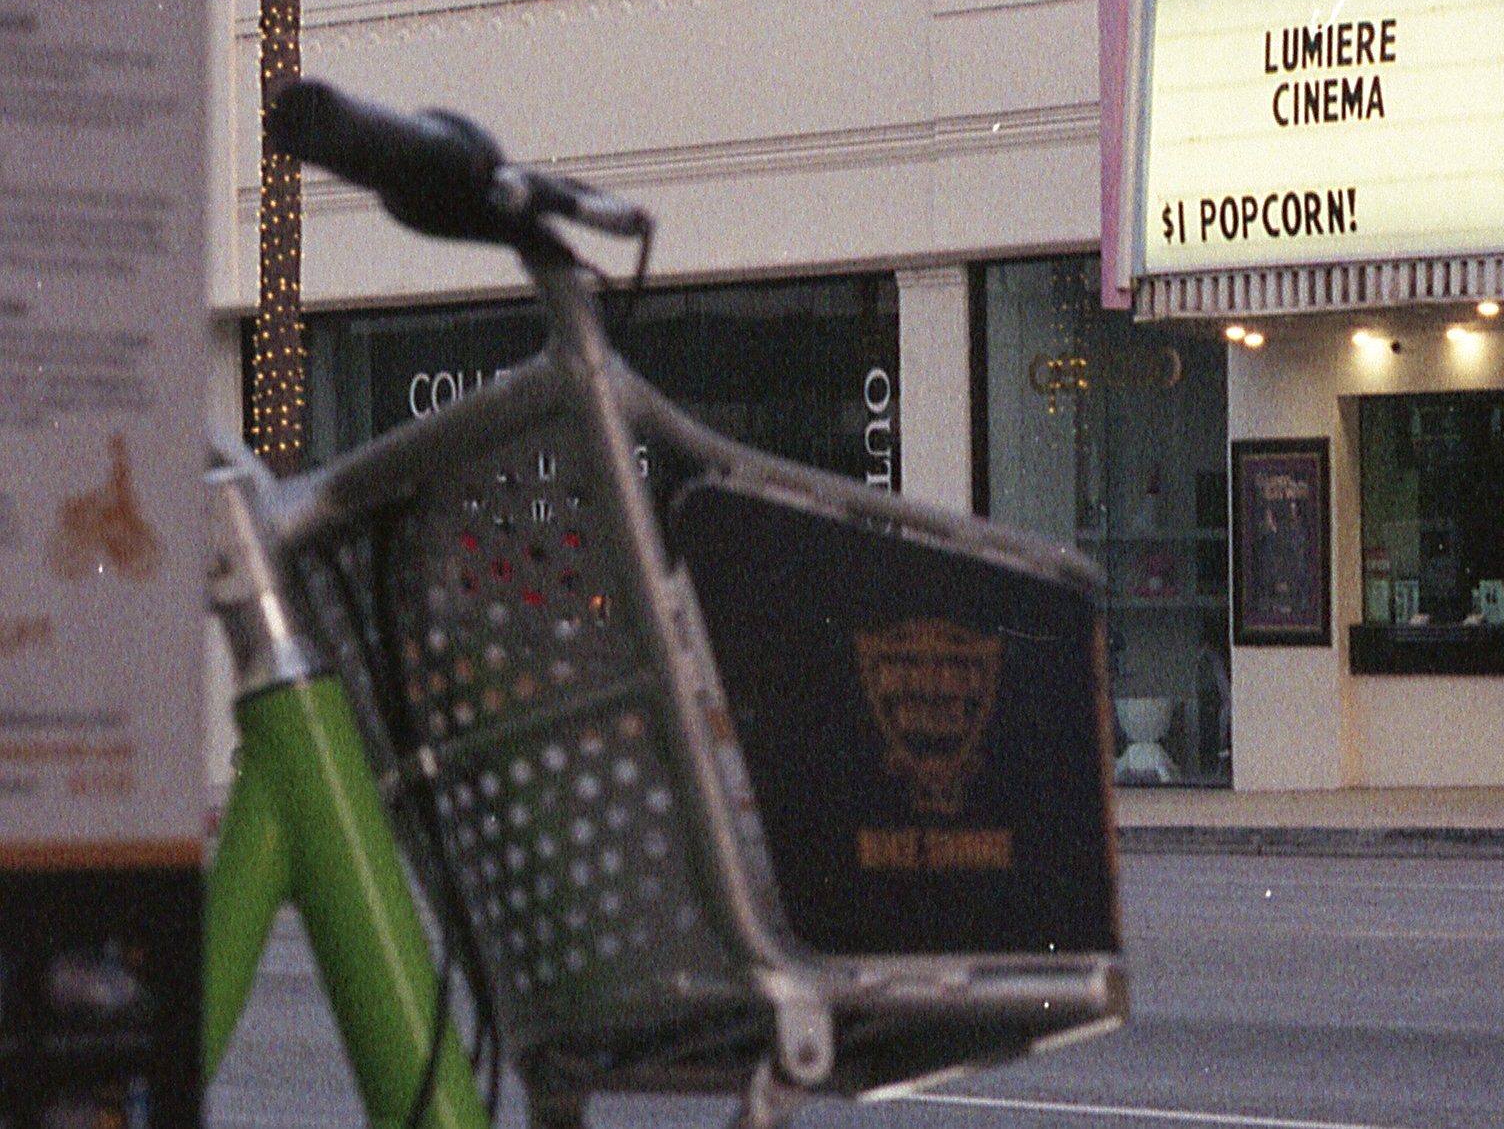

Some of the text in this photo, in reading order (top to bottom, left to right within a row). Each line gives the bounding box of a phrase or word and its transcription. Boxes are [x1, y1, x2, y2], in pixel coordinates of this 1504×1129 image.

[1264, 19, 1397, 74] LUMIERE
[1272, 74, 1386, 127] CINEMA
[1200, 188, 1359, 242] POPCORN!
